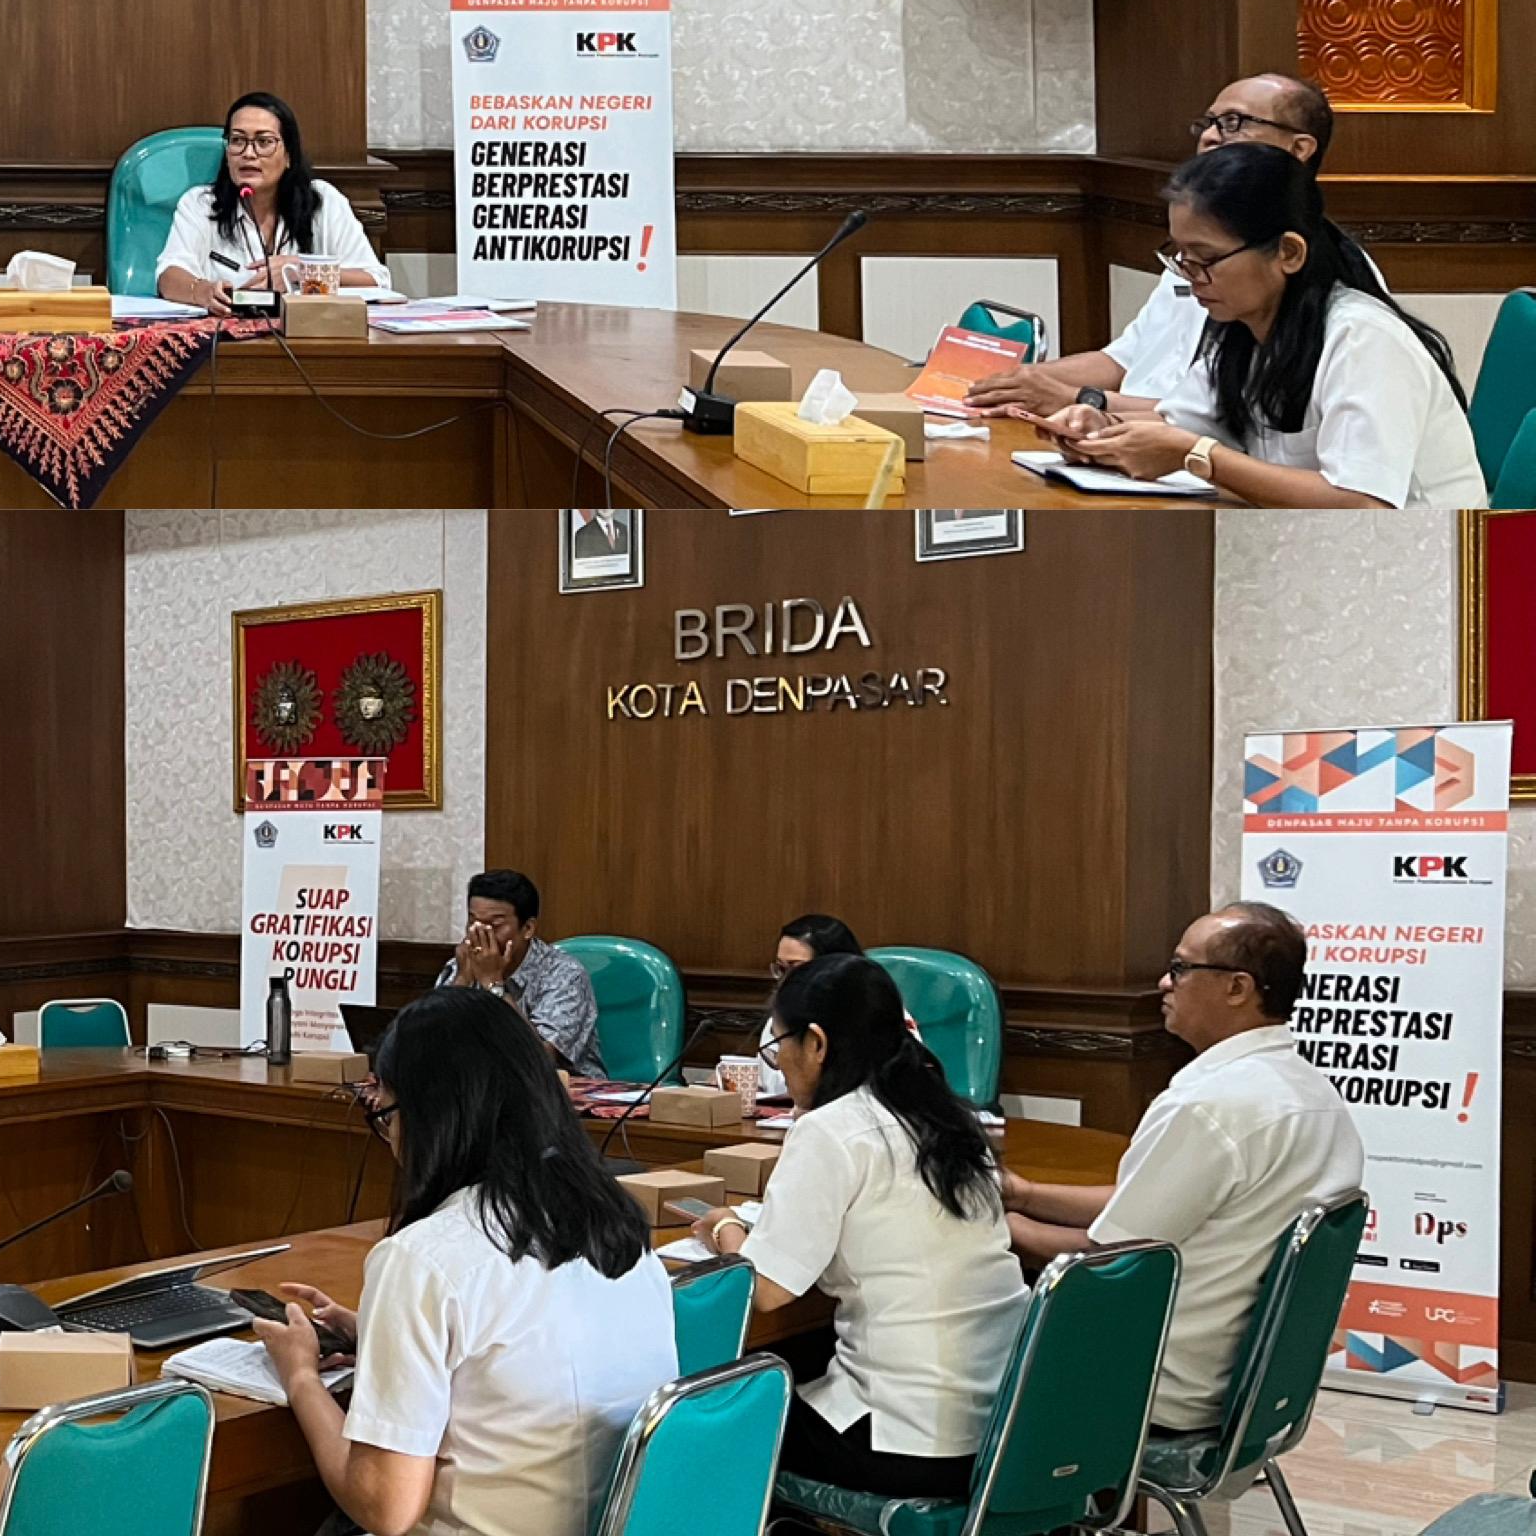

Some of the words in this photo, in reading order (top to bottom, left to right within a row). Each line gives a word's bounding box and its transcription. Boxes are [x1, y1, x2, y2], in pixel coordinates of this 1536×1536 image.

[576, 32, 636, 52] KPK
[470, 95, 573, 110] BEBASKAN
[580, 95, 652, 110] NEGERI
[470, 115, 516, 131] DARI
[523, 115, 608, 131] KORUPSI
[471, 141, 587, 167] GENERASI
[471, 173, 630, 198] BERPRESTASI
[472, 204, 588, 229] GENERASI
[473, 235, 632, 261] ANTIKORUPSI
[674, 595, 872, 661] BRIDA
[606, 680, 707, 720] KOTA
[726, 667, 949, 715] DENPASAR
[324, 824, 362, 840] KPK
[1267, 818, 1332, 828] DENPASAR
[1337, 818, 1373, 827] MAJU
[1379, 818, 1419, 827] TANPA
[1425, 817, 1485, 827] KORUPSI
[1394, 855, 1469, 878] KPK
[296, 888, 350, 910] SUAP
[250, 912, 374, 939] GRATIFIKASI
[1305, 924, 1387, 942] ASKAN
[1395, 925, 1484, 944] NEGERI
[272, 939, 361, 965] KORUPSI
[1324, 946, 1427, 964] KORUPSI
[1301, 973, 1400, 1004] NERASI
[1291, 1006, 1453, 1041] RPRESTASI
[1297, 1039, 1400, 1072] NERASI
[1414, 1212, 1468, 1245] Dps
